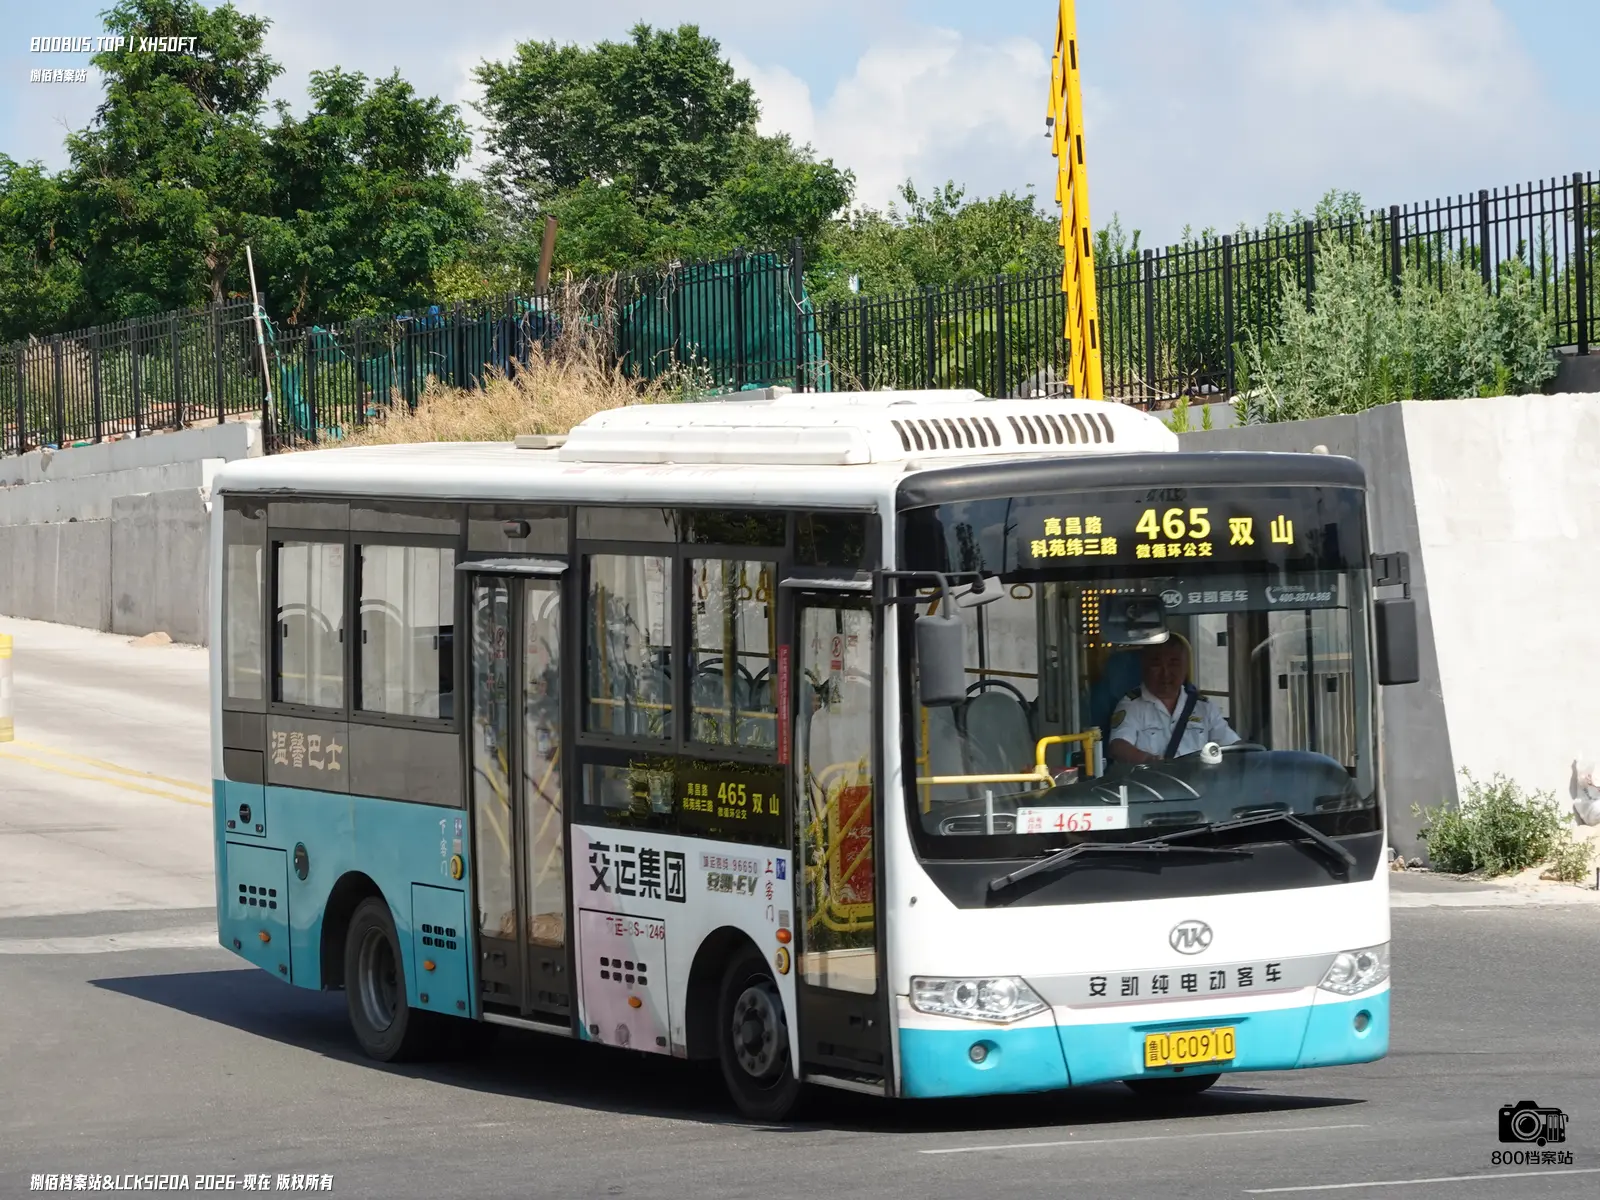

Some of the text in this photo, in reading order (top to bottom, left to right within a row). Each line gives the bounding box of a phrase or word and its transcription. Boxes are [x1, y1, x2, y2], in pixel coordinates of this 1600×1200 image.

[1043, 516, 1103, 536] 高昌路
[1135, 507, 1211, 540] 465
[1228, 515, 1294, 546] 双山
[1030, 537, 1118, 558] 科苑纬三路
[1135, 542, 1213, 559] 微循环公交
[1187, 590, 1249, 604] 安凯客车
[271, 730, 343, 771] 温馨巴士
[717, 781, 747, 807] 465
[752, 793, 780, 815] 双山
[1053, 812, 1093, 832] 465
[588, 841, 687, 904] 交运集团
[732, 859, 758, 875] 96650
[1089, 962, 1282, 997] 安凯纯电动客车
